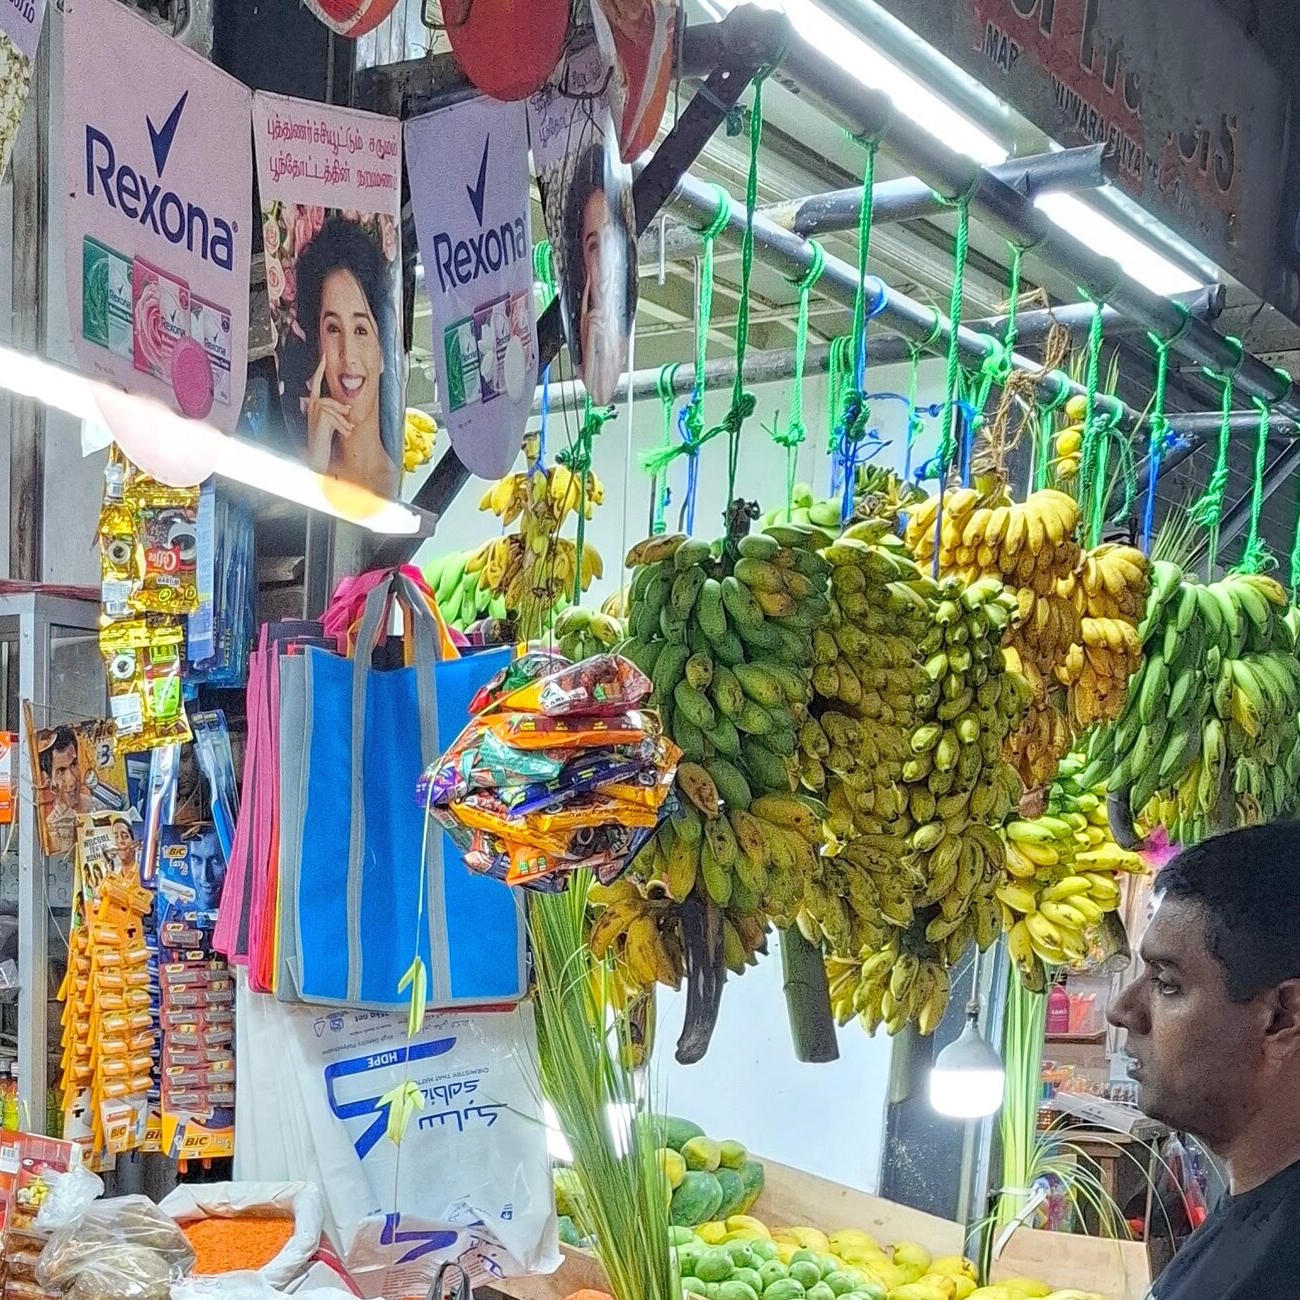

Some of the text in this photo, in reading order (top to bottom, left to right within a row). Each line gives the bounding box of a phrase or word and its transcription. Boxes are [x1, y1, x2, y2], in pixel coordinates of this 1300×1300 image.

[86, 124, 233, 272] Rexona
[433, 214, 528, 294] Rexona
[367, 1051, 398, 1070] HDPE
[435, 1072, 452, 1082] THAT
[452, 1067, 490, 1080] CHEMISTRY
